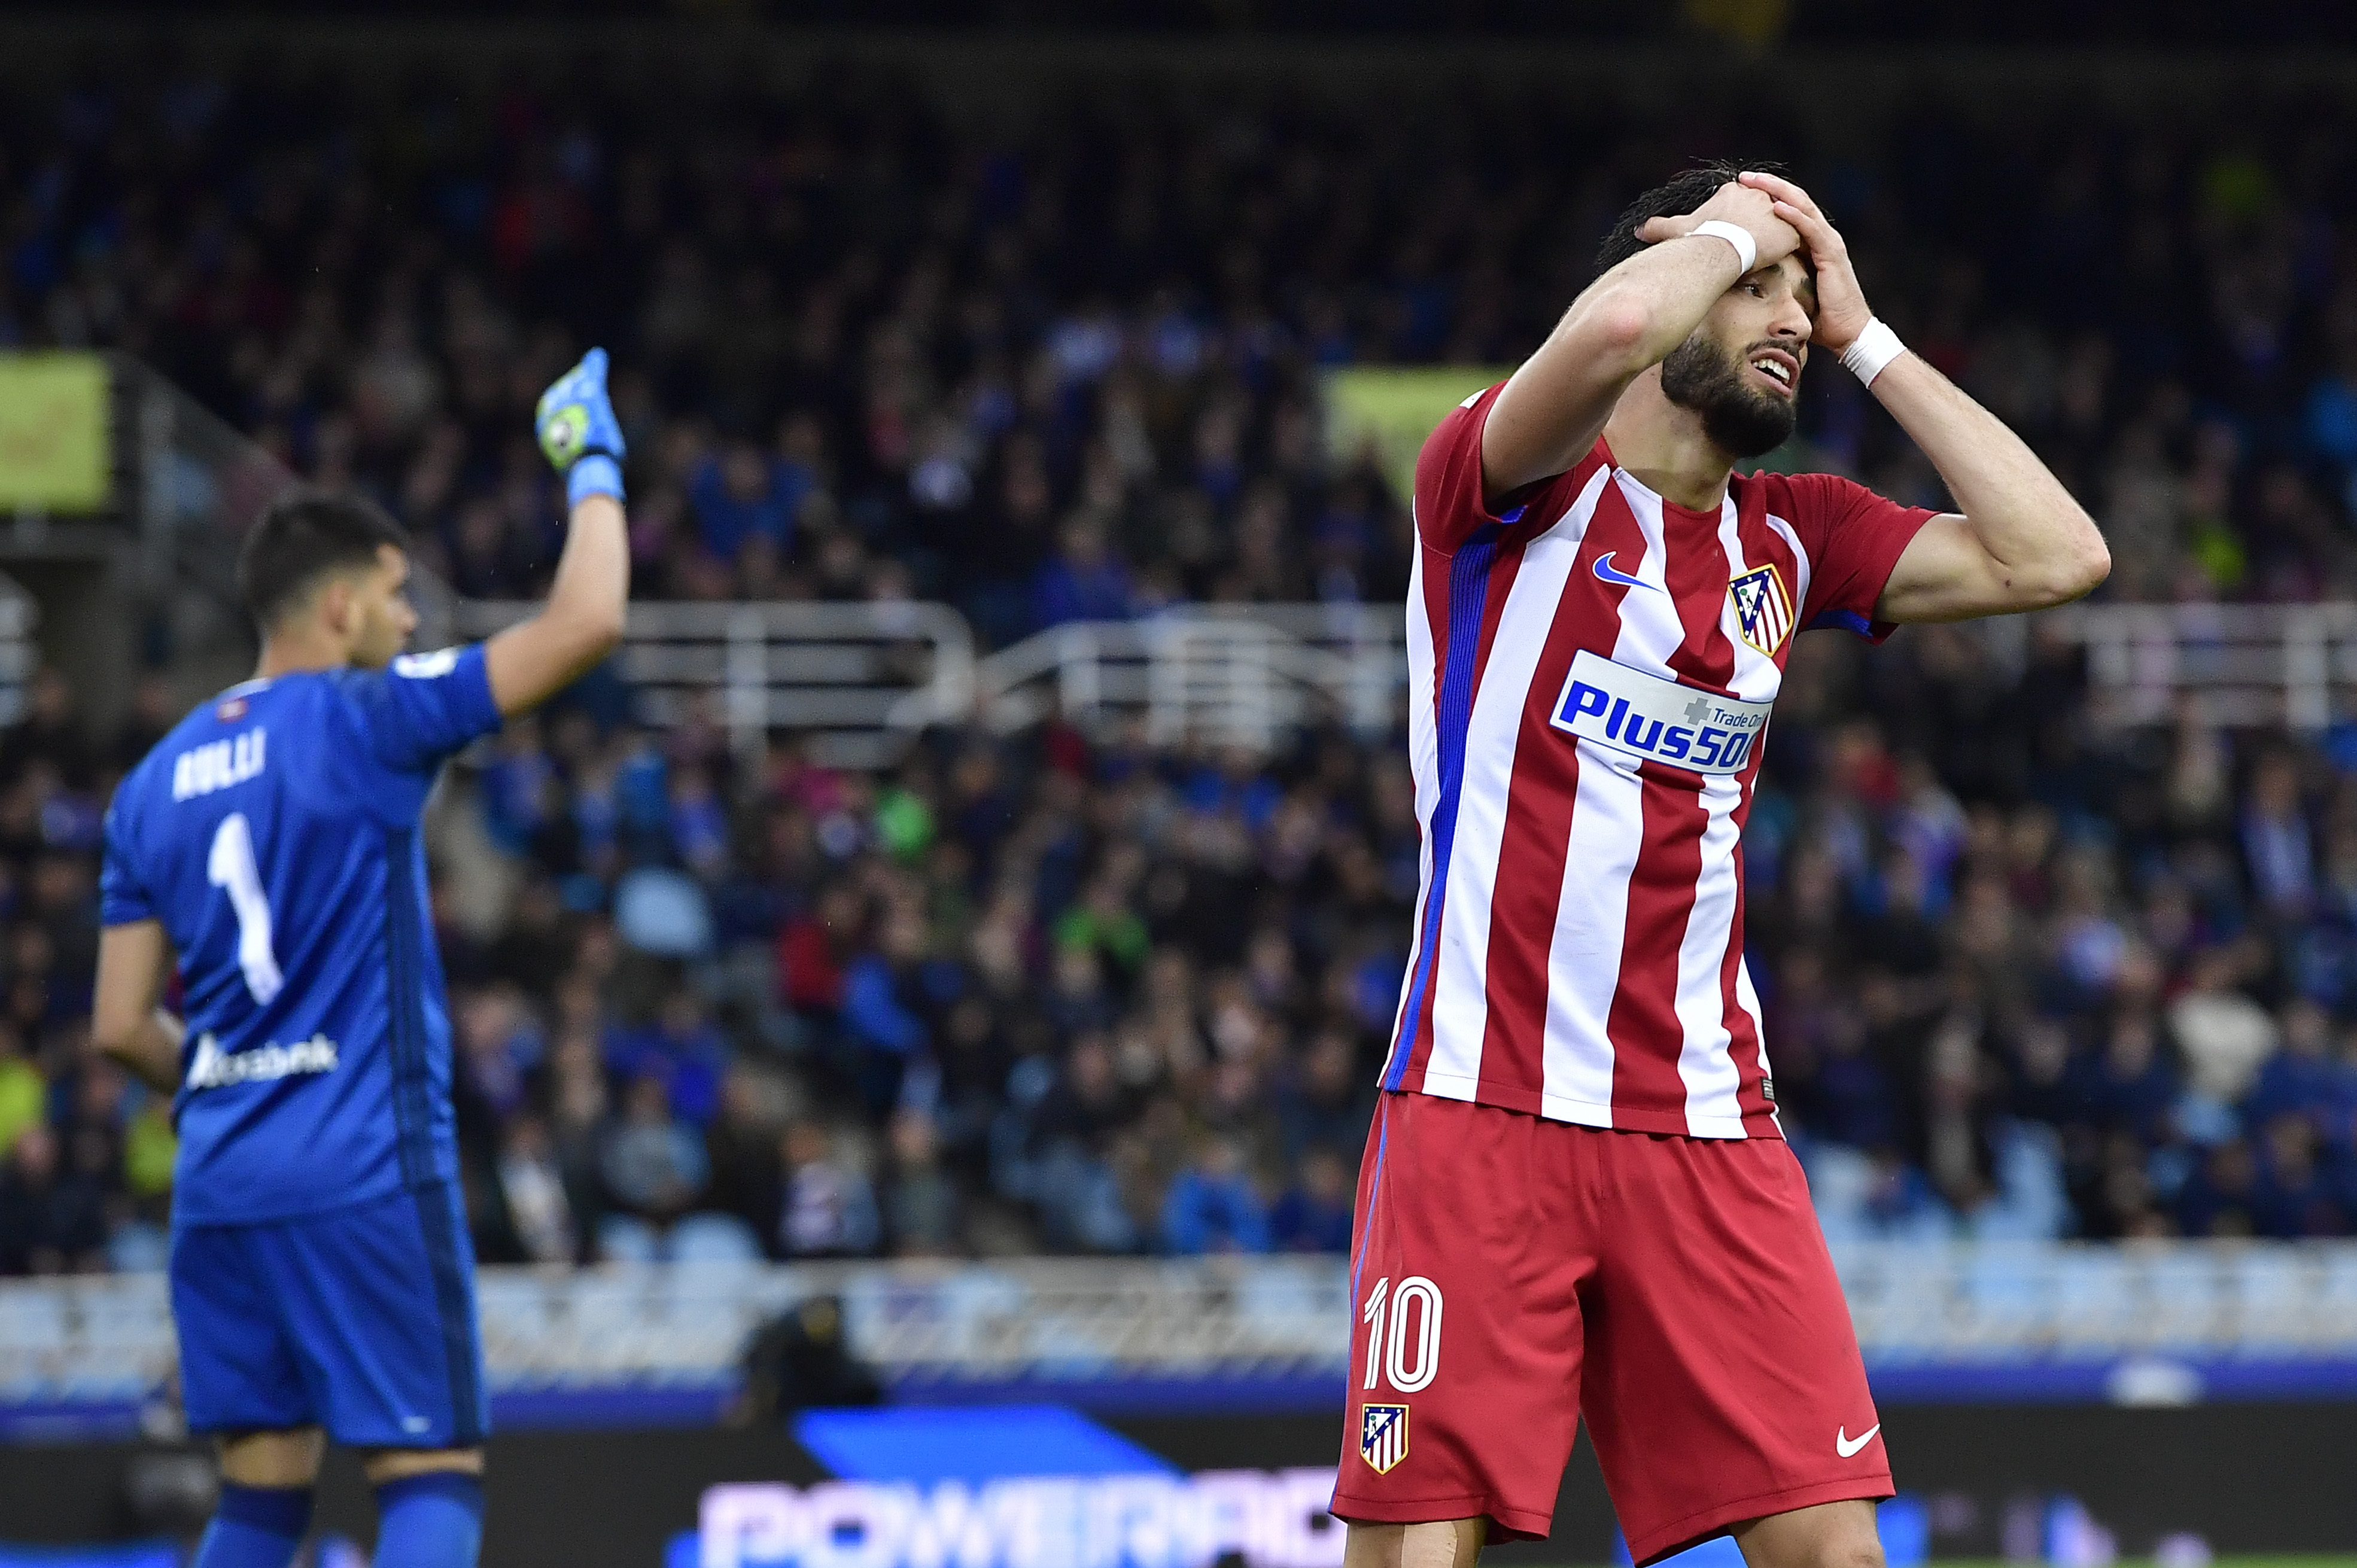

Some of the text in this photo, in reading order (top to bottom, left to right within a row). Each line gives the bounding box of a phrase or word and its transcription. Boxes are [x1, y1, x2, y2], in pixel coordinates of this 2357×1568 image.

[1713, 708, 1748, 727] Trade
[207, 812, 284, 1006] 1
[1363, 1275, 1443, 1393] 10
